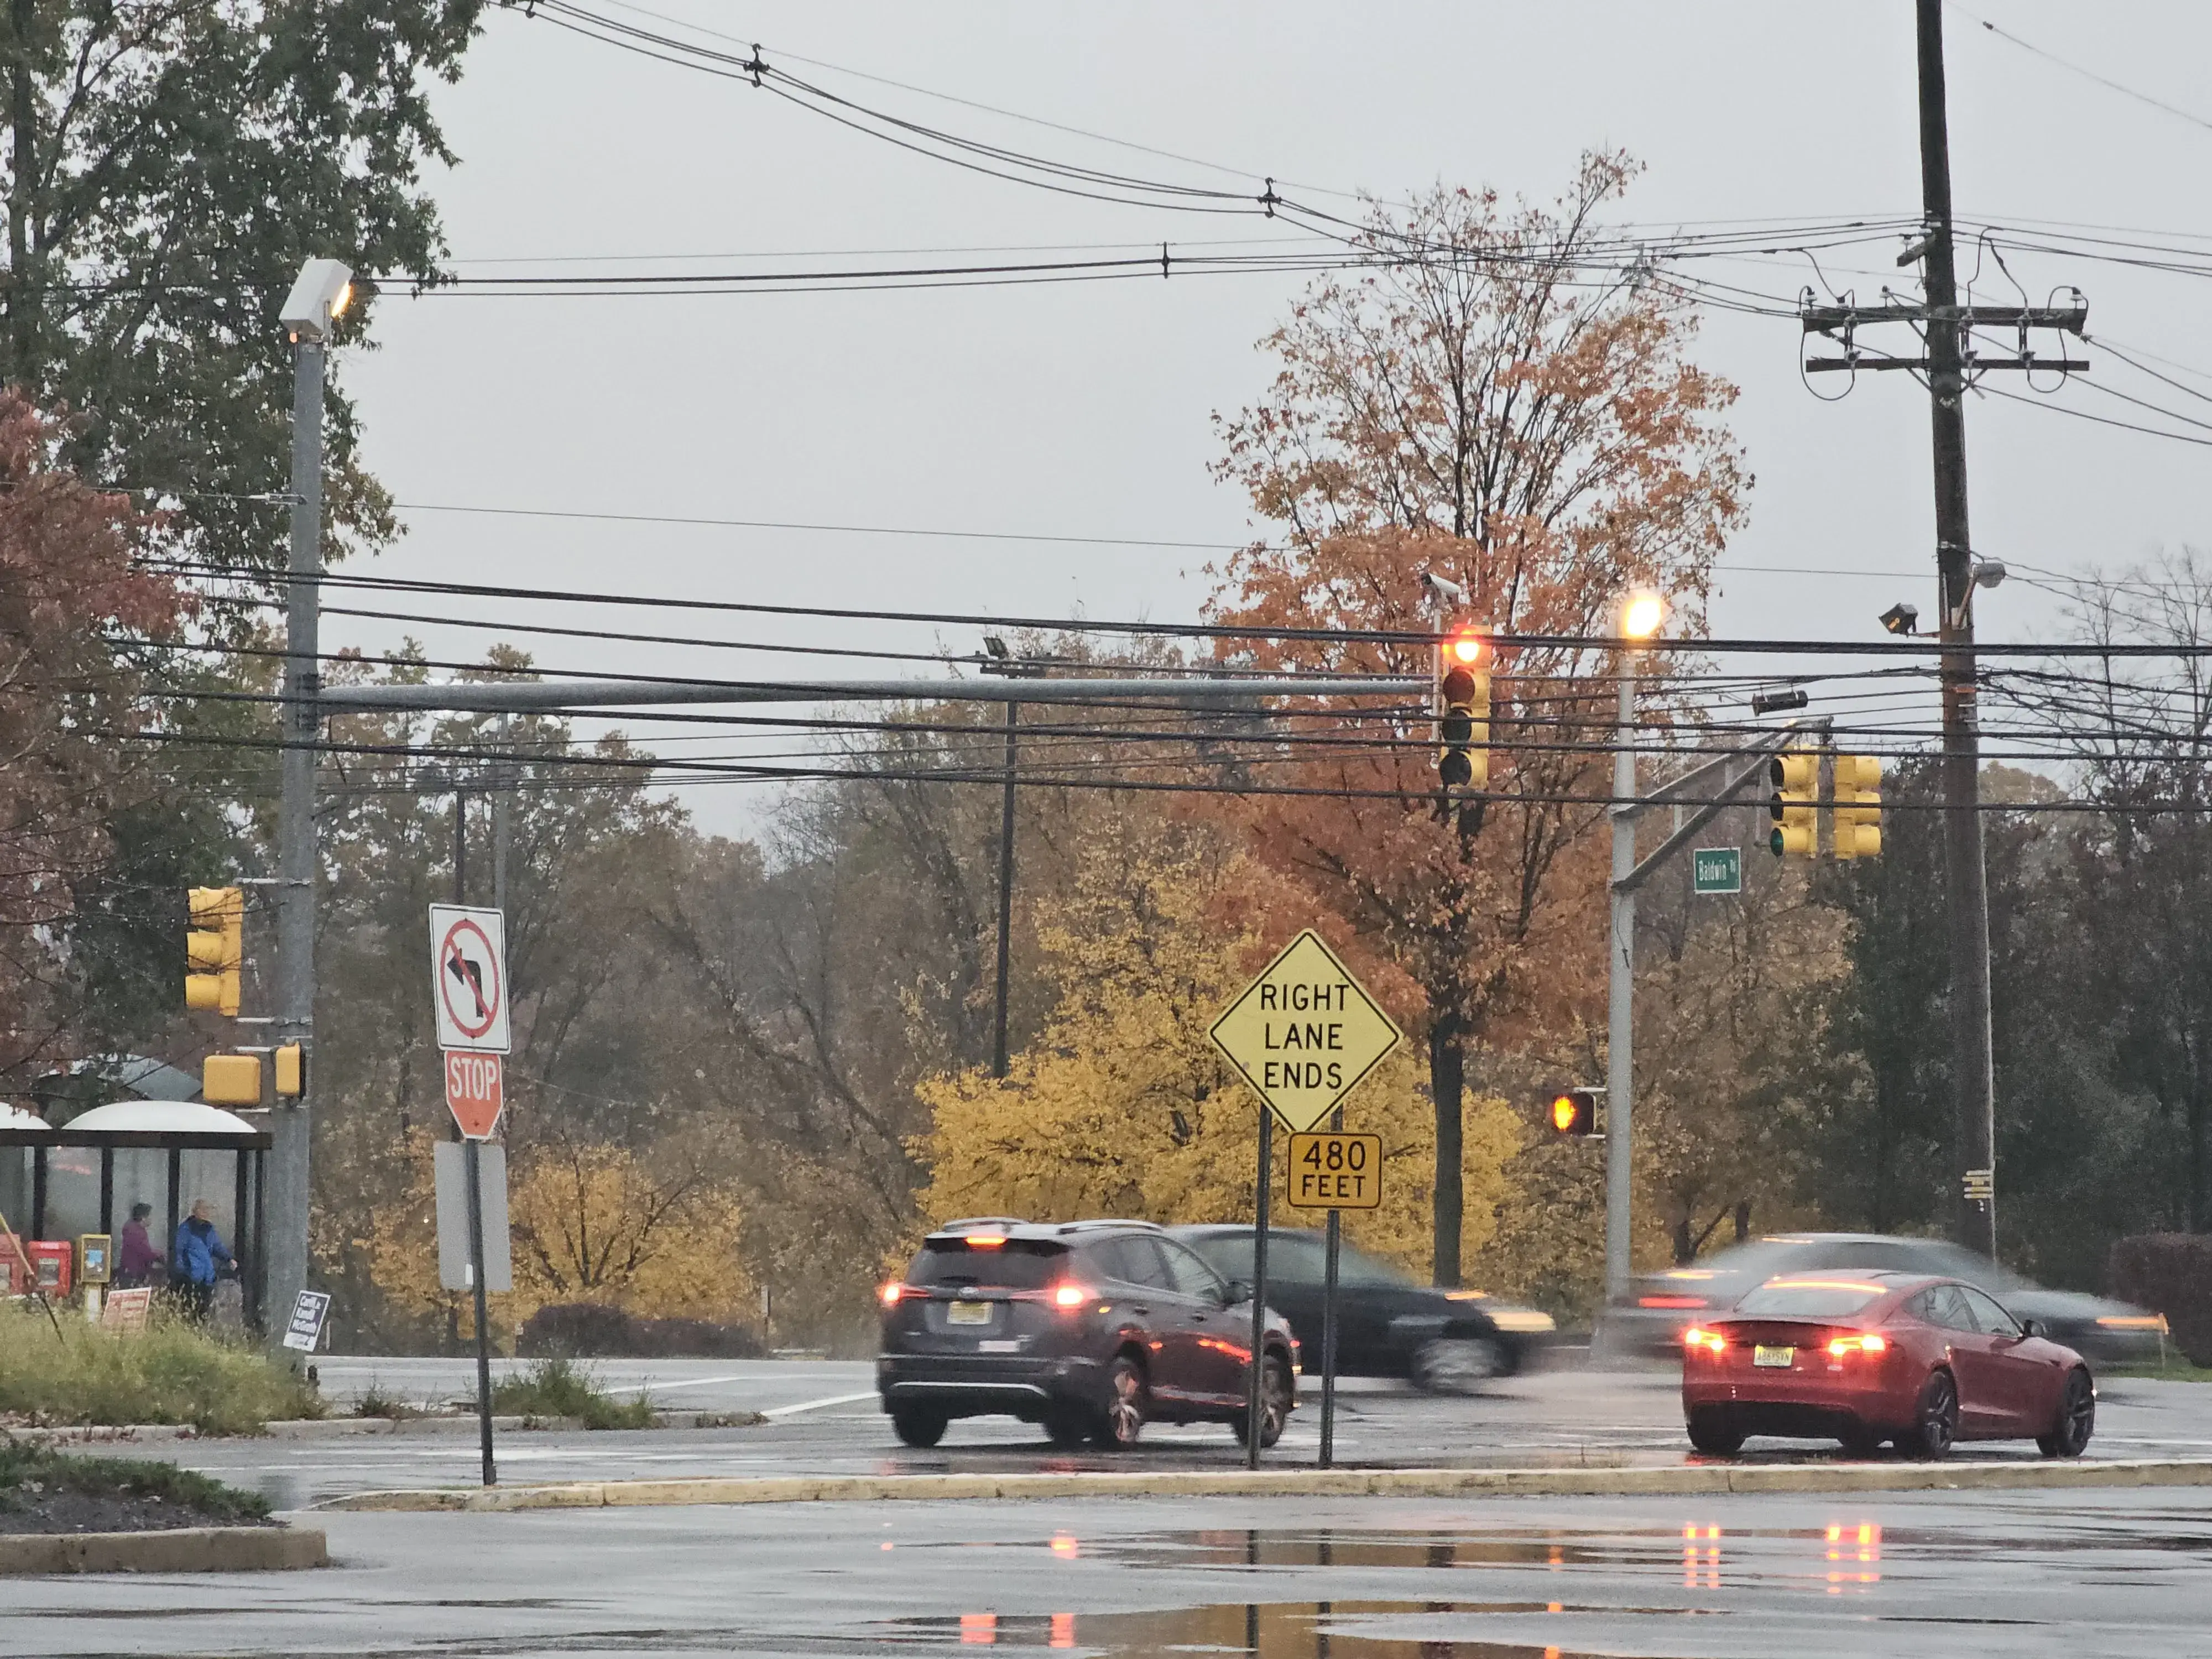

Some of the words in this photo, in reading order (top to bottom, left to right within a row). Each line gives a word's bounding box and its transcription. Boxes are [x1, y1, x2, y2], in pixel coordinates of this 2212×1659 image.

[1260, 984, 1349, 1011] RIGHT
[1265, 1022, 1343, 1050] LANE
[450, 1056, 497, 1100] STOP
[1264, 1062, 1342, 1090] ENDS
[1302, 1140, 1366, 1171] 480
[1301, 1174, 1366, 1198] FEET
